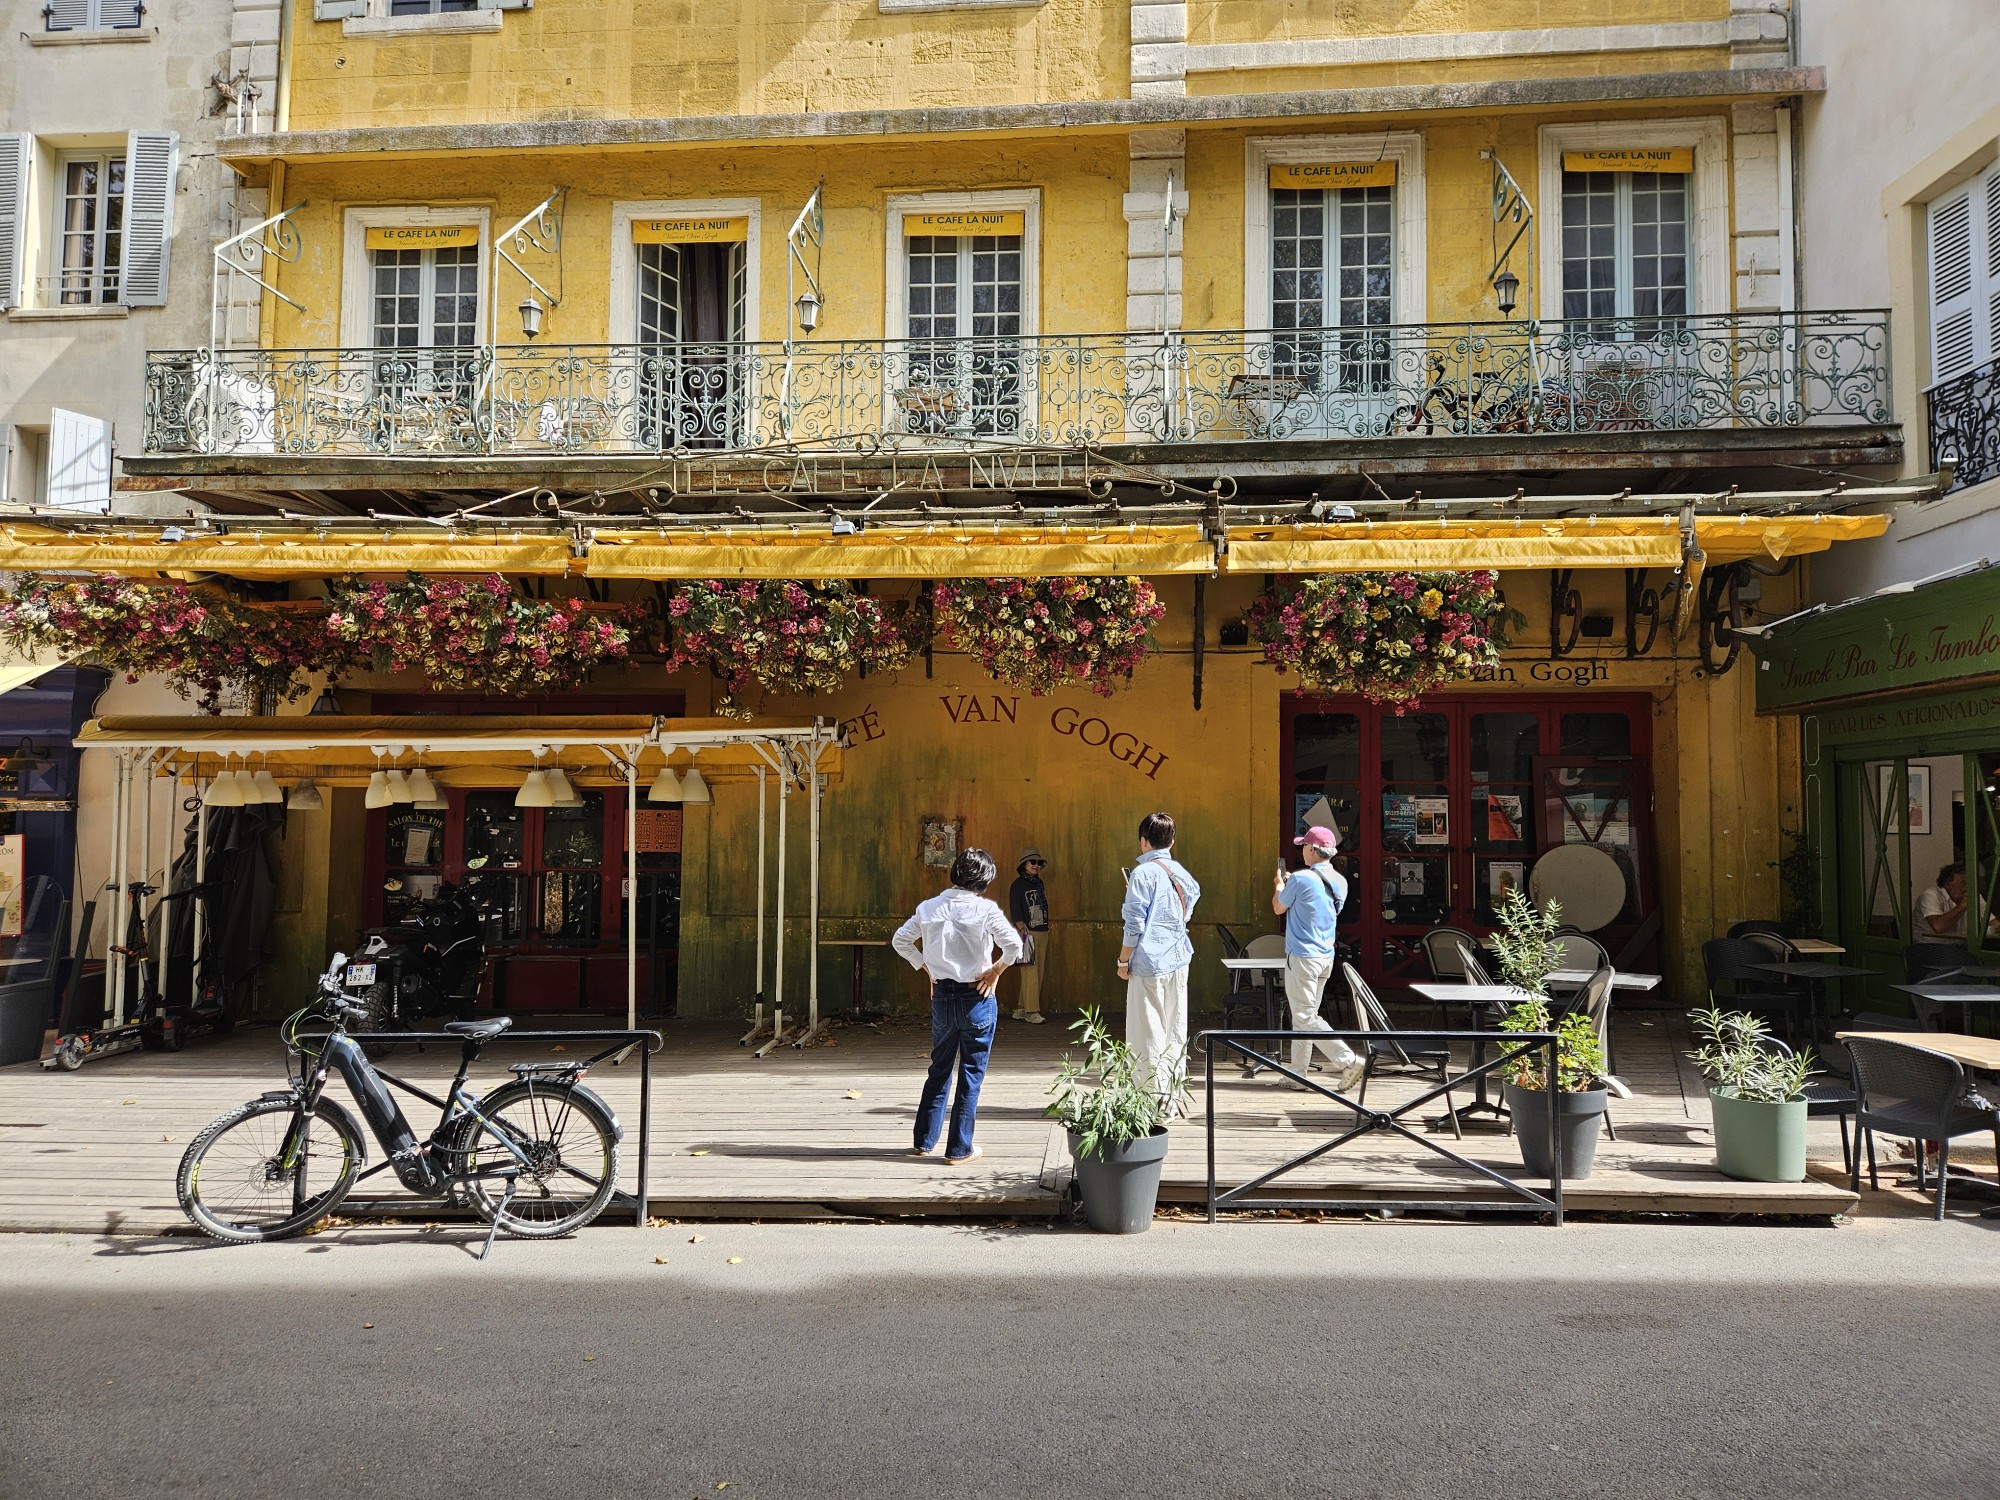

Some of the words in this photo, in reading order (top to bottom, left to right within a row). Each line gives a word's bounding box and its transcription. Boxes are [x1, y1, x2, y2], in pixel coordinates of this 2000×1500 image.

[1648, 152, 1671, 160] NUIT
[1304, 167, 1330, 175] CAFE
[1351, 165, 1374, 174] NUIT
[693, 222, 705, 230] LA
[708, 221, 730, 229] NUIT
[384, 230, 394, 238] LE
[687, 460, 739, 494] LE
[763, 459, 867, 493] CAFE
[892, 455, 943, 491] LA
[1781, 649, 1835, 690] Snack
[1836, 644, 1878, 681] Bar
[1887, 632, 1918, 671] Le
[1530, 659, 1609, 686] Gogh
[1828, 718, 1857, 735] BAR
[939, 695, 1020, 724] VAN
[1050, 706, 1169, 781] GOGH
[388, 814, 414, 828] SALON
[416, 814, 427, 822] DE
[391, 838, 400, 848] Le
